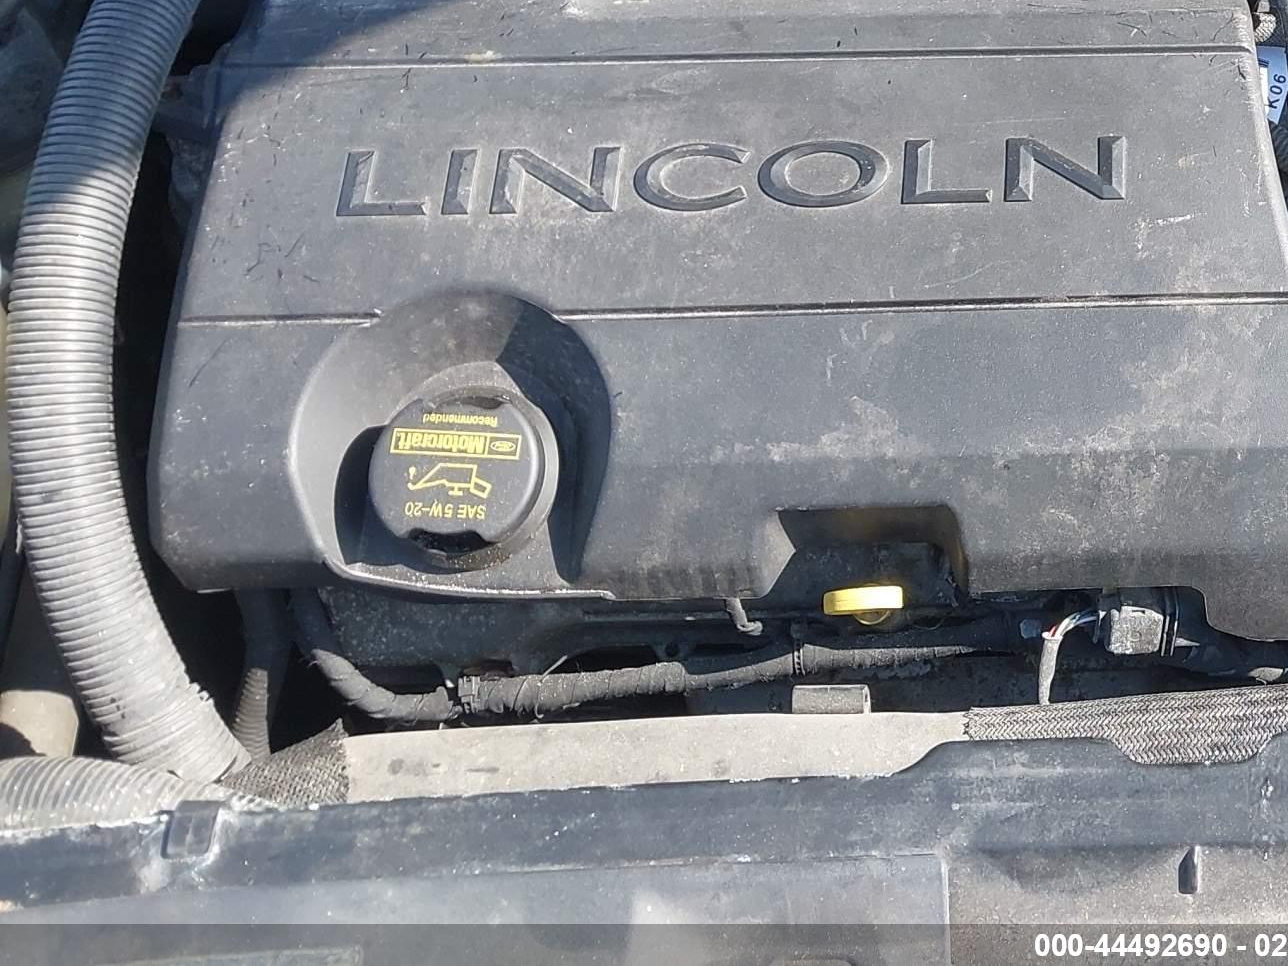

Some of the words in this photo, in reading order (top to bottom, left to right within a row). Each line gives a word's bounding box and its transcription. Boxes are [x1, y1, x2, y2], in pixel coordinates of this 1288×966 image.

[1264, 73, 1287, 110] K06
[334, 134, 1127, 217] LINCOLN
[422, 412, 498, 428] Recommended
[457, 503, 487, 520] SAE
